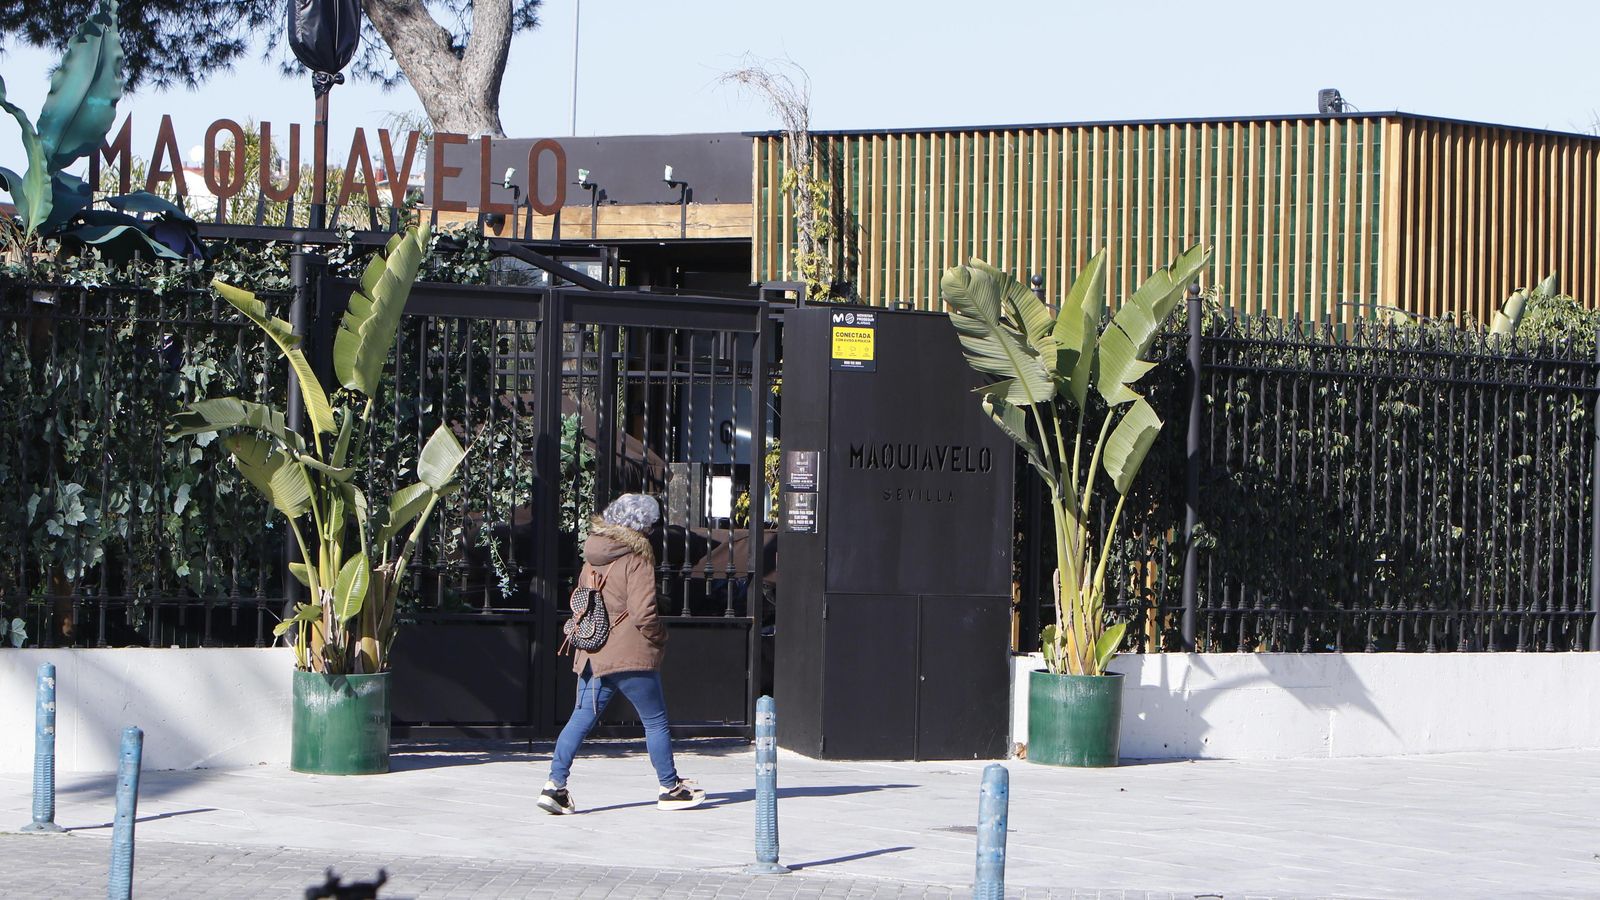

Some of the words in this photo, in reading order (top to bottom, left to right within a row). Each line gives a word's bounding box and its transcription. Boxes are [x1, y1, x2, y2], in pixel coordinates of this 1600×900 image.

[89, 110, 568, 217] MAQUIAVELO
[835, 331, 871, 339] CONECTADA
[850, 443, 993, 474] MAQUIAVELO
[882, 488, 955, 503] SEVILLA
